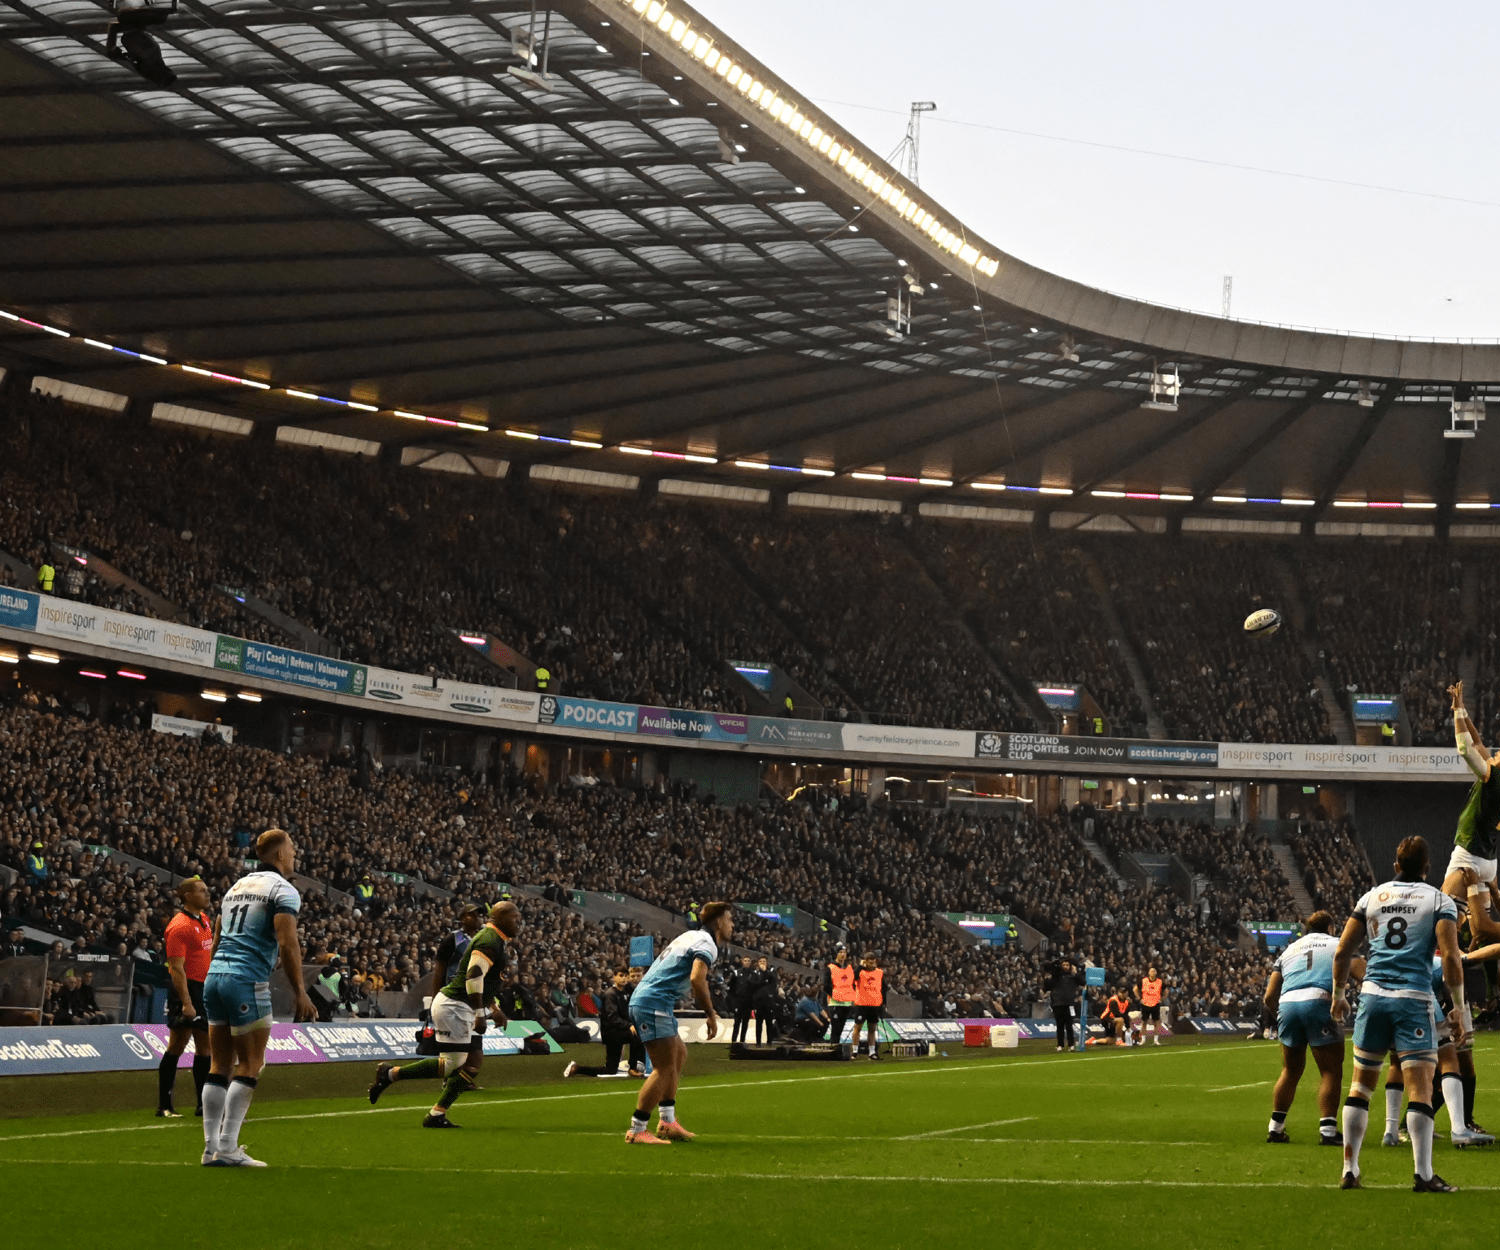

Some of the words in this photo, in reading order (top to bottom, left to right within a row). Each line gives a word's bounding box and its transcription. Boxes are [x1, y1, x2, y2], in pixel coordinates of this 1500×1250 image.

[218, 652, 239, 665] GAME
[246, 646, 262, 662] Play
[266, 651, 286, 667] Coach
[290, 656, 314, 671] Referee
[318, 661, 348, 677] Volunteer
[369, 680, 404, 693] FAIRWAYS
[451, 693, 492, 706] FAIRWAYS
[563, 704, 635, 727] PODCAST
[641, 715, 687, 731] Available
[688, 721, 713, 733] Now
[719, 719, 745, 728] OFFICIAL
[787, 730, 832, 739] MURRAYFIELD
[857, 734, 960, 747] murrayfieldexperience.com
[1009, 734, 1059, 745] SCOTLAND
[1009, 743, 1070, 754] SUPPORTERS
[1074, 746, 1097, 755] JOIN
[1099, 747, 1125, 756] NOW
[1130, 748, 1218, 762] scottishrugby.org
[1008, 751, 1033, 760] CLUB
[233, 894, 243, 902] DER
[244, 894, 268, 903] MERWE
[1381, 906, 1417, 914] DEMPSEY
[228, 903, 250, 934] 11
[1384, 916, 1408, 950] 8
[1303, 949, 1314, 971] 1
